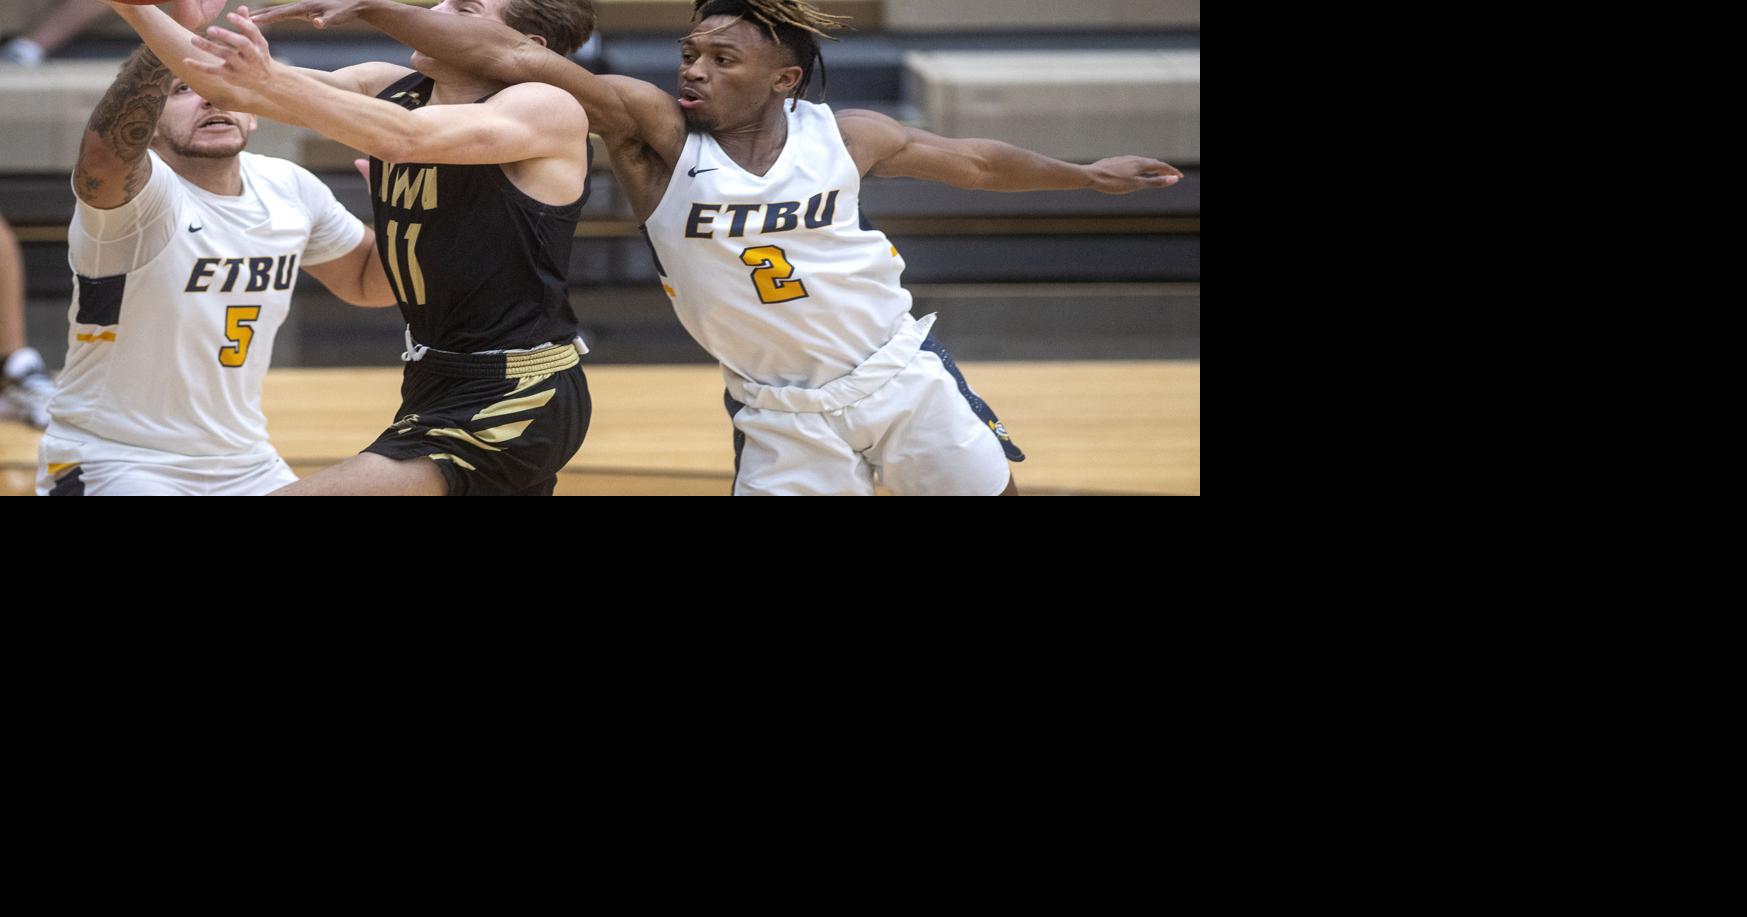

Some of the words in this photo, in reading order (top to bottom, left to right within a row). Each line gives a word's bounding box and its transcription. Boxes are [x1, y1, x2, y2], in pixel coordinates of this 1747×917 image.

[685, 189, 840, 239] ETBU
[184, 253, 297, 293] ETBU
[386, 219, 426, 305] 11
[739, 244, 809, 304] 2
[218, 304, 262, 367] 5
